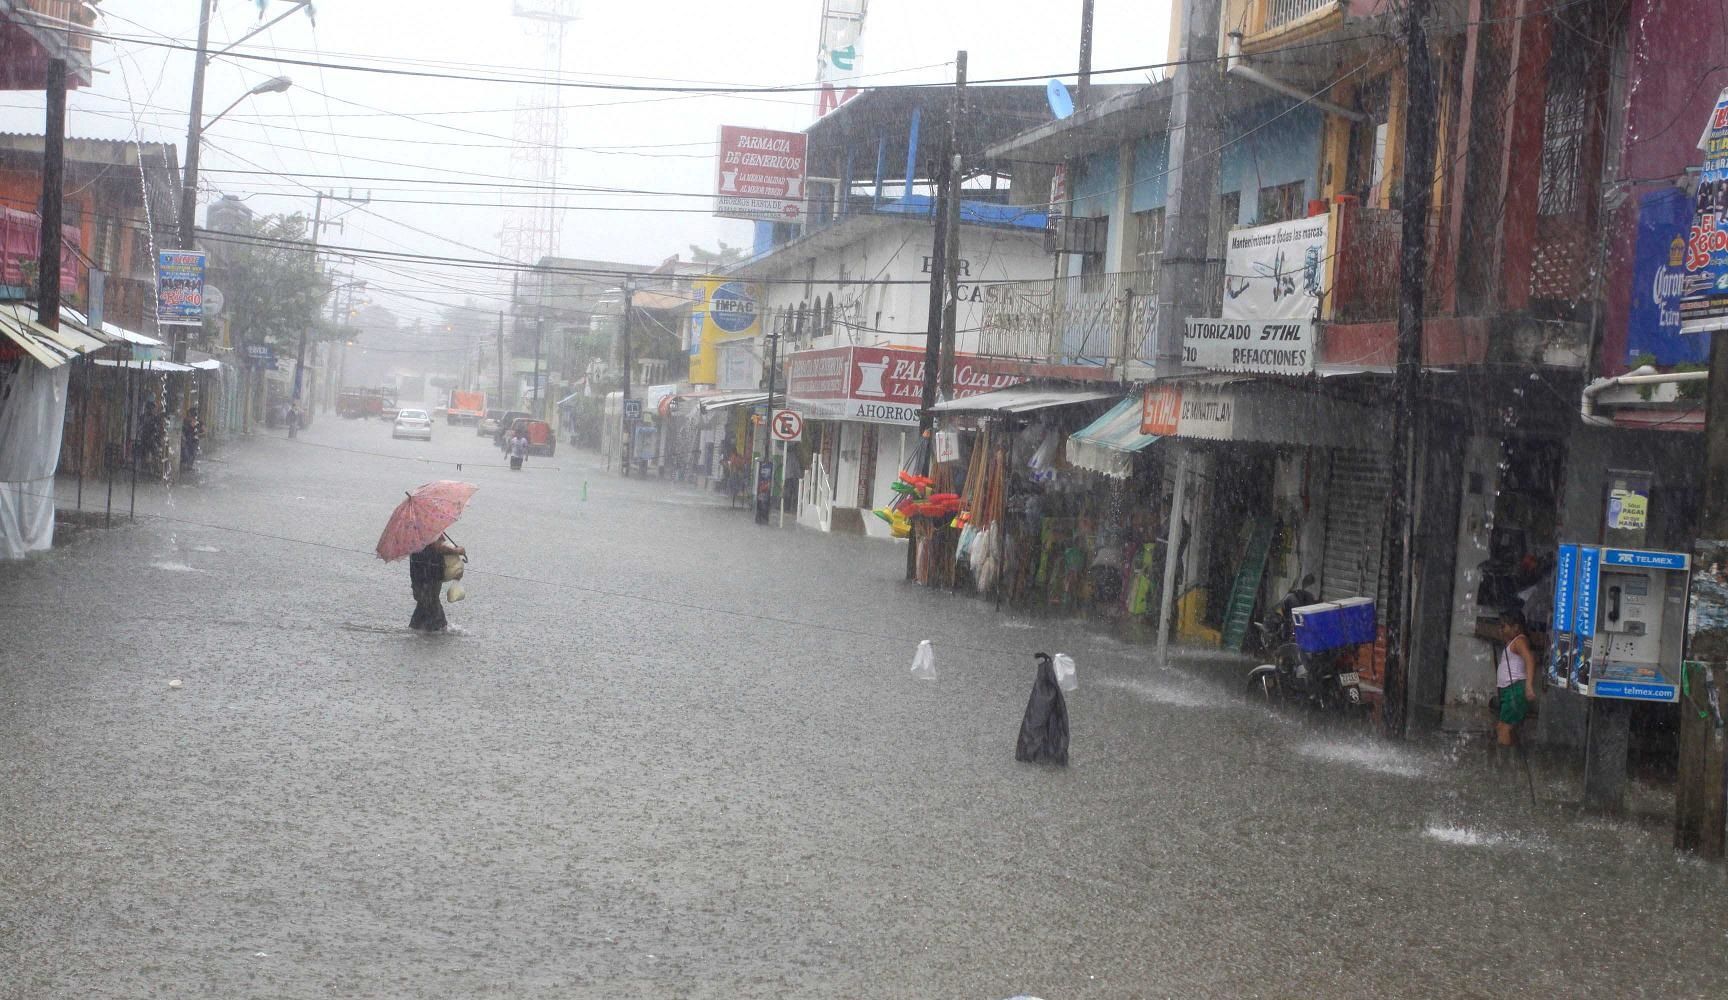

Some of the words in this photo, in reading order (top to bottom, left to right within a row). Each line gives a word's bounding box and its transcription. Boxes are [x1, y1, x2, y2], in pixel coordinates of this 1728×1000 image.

[737, 135, 790, 153] FARMACIA
[725, 151, 741, 164] DE
[741, 152, 800, 170] GENERICOS
[751, 198, 771, 209] HASTA
[1702, 214, 1715, 232] El
[1232, 233, 1271, 249] Mantenimiento
[1272, 234, 1276, 244] a
[1293, 224, 1302, 241] las
[1303, 226, 1323, 239] marcas
[1686, 225, 1728, 271] Reco
[1653, 264, 1684, 304] Coron
[1184, 323, 1251, 340] AUTORIZADO
[1260, 325, 1301, 340] STIHL
[1233, 348, 1306, 366] REFACCIONES
[891, 359, 990, 386] FARCIA
[892, 384, 910, 396] LA
[856, 403, 920, 422] AHORROS
[1144, 391, 1177, 425] STIHL
[1182, 401, 1190, 420] DE
[1190, 401, 1231, 422] MINATITLAN
[781, 416, 793, 434] E
[1635, 556, 1673, 565] TELMEX
[1624, 686, 1672, 697] telmex.com
